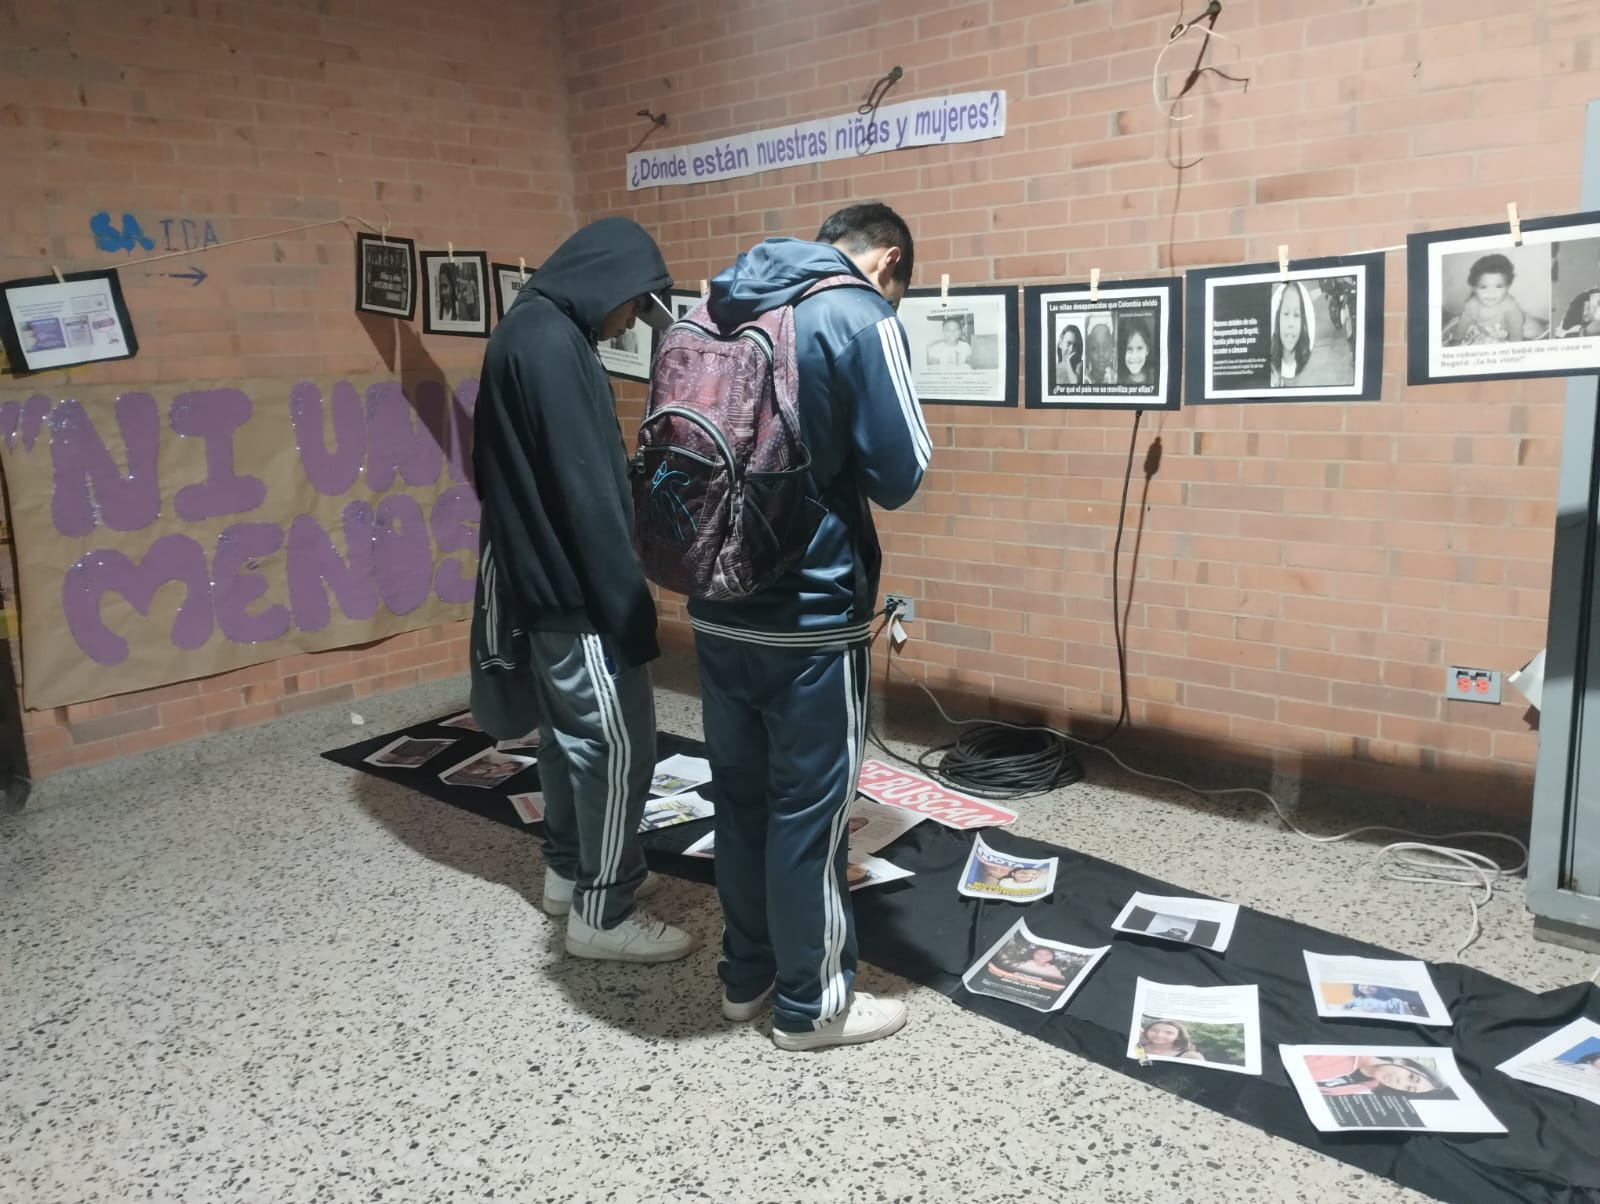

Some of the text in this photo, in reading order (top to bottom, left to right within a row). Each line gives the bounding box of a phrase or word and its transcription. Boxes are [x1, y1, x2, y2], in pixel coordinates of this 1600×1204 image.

[631, 91, 1000, 188] ¿Dónde están nuestras niñas y mujeres?
[863, 777, 1007, 827] BUSCAN
